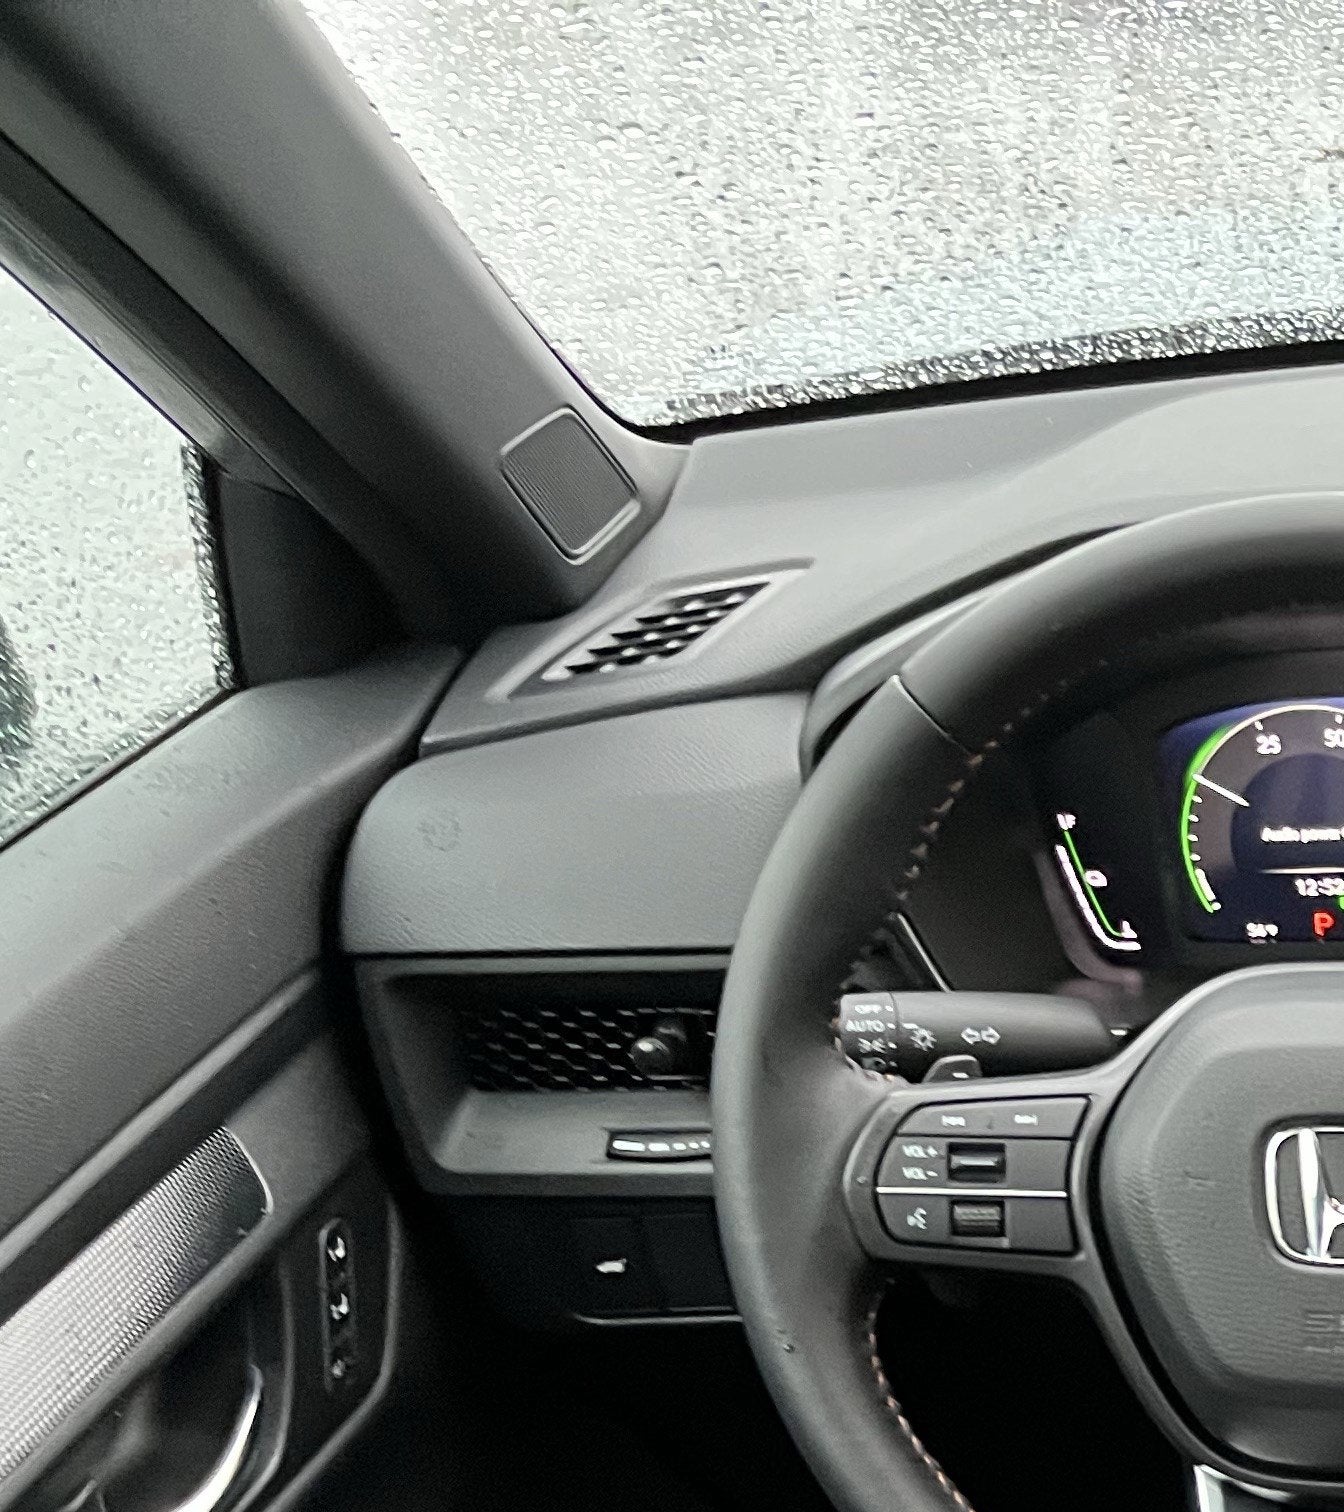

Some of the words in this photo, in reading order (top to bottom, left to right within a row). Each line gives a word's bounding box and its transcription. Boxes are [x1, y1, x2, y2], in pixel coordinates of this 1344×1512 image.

[1256, 734, 1281, 755] 25
[1313, 911, 1335, 937] P
[845, 1019, 885, 1033] AUTO
